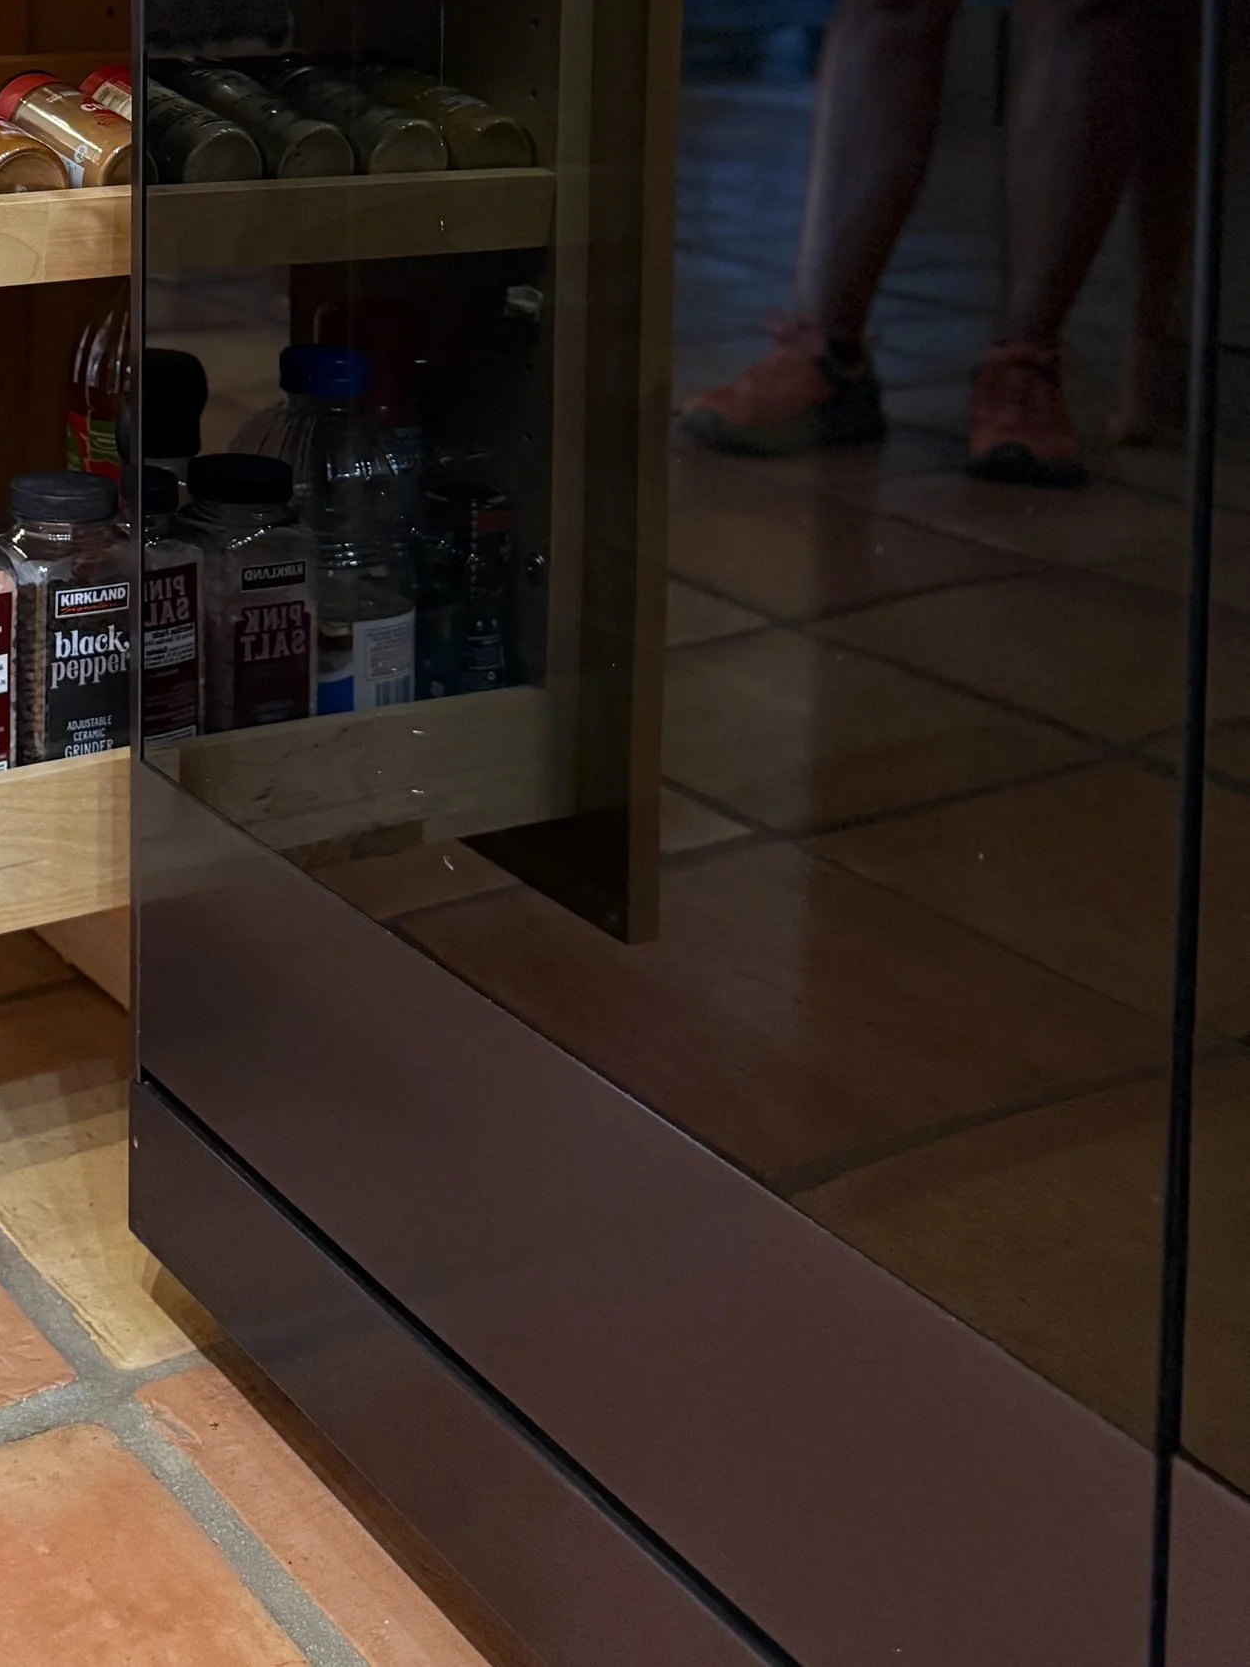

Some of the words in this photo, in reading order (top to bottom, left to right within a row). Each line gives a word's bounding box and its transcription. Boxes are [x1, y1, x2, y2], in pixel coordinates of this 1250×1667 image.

[60, 587, 126, 607] KIRKLAND
[54, 624, 130, 659] black
[50, 651, 130, 689] pepper
[67, 714, 112, 731] ADJUSTABLE
[73, 728, 106, 742] CERAMIC
